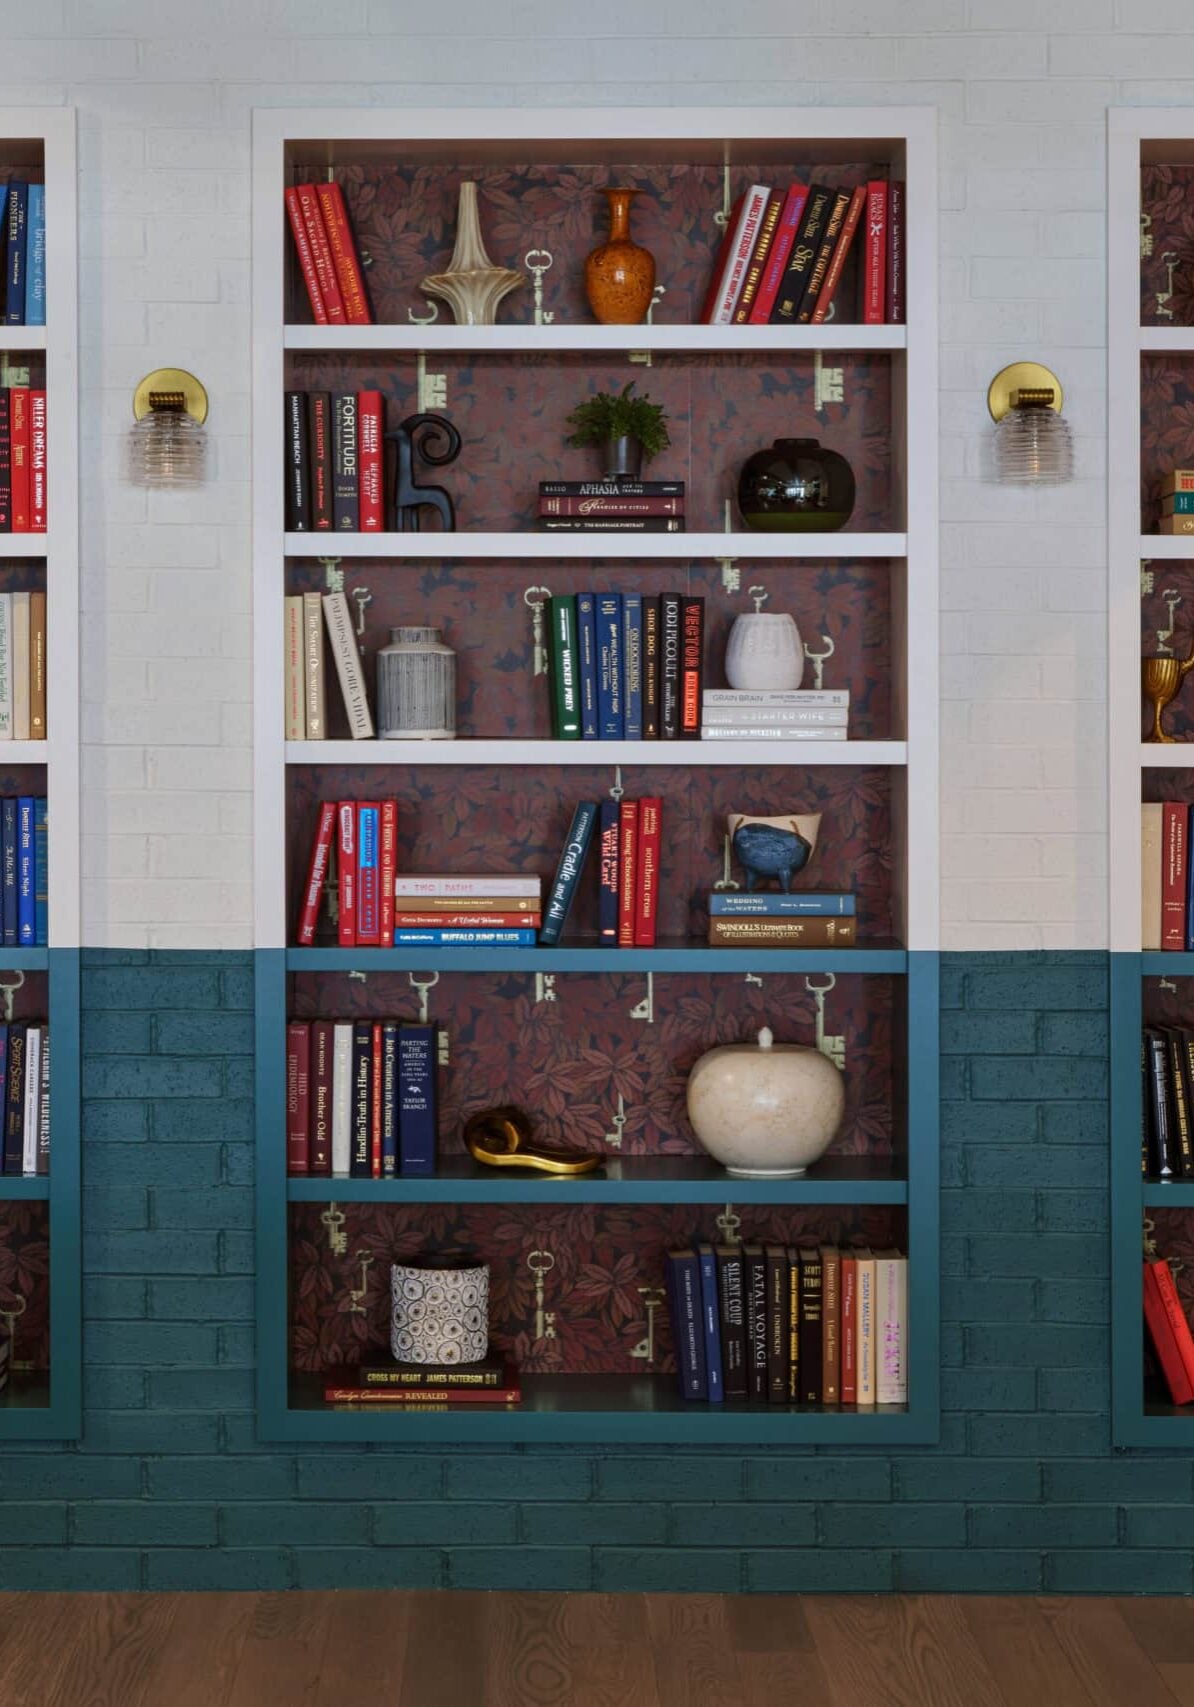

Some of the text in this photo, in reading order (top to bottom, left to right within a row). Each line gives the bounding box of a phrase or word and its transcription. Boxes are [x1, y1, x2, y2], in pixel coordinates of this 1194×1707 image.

[9, 192, 18, 240] PIONEERS
[737, 195, 764, 259] JAMES PATTERSON
[764, 200, 781, 232] THOMAS
[33, 228, 46, 263] bridge
[298, 233, 314, 277] AMERICAN
[301, 196, 330, 293] OUR SACRED HONOR
[755, 233, 771, 261] HARRIS
[790, 244, 815, 276] STAR
[31, 278, 44, 299] clay
[748, 267, 760, 284] CARI
[808, 257, 828, 296] COTTAGE
[33, 398, 45, 428] KILLER
[291, 396, 299, 438] MANHATTAN
[315, 400, 324, 460] THE CURIOSITY
[33, 432, 45, 469] DREAMS
[342, 397, 355, 476] FORTITUDE
[362, 415, 370, 454] CORNWELL
[370, 416, 378, 453] PATRICIA
[370, 463, 378, 504] DEPRAVED
[579, 484, 619, 495] APHASIA
[309, 615, 317, 629] THE
[647, 608, 655, 632] SHOE
[309, 631, 318, 657] SMART
[647, 636, 655, 656] DOG
[665, 601, 678, 680] JODI PICOULT
[330, 597, 368, 732] PALIMPSEST GORE VIDAL
[562, 649, 572, 685] WICKED
[631, 628, 639, 692] ON DOCTORING
[685, 605, 700, 722] VECTOR ROBIN COOK
[564, 687, 574, 712] PREY
[739, 694, 763, 702] BRAIN
[799, 712, 824, 721] WIFE
[313, 869, 322, 879] for
[314, 843, 327, 869] Intended
[549, 811, 589, 920] PATTERSON Cradle and All
[602, 830, 610, 885] Wild Card
[623, 829, 633, 911] Among Schoolchildren
[643, 848, 654, 890] southern
[442, 933, 475, 941] BUFFALO
[477, 933, 495, 941] JUMP
[497, 933, 519, 941] BLUES
[386, 1039, 395, 1053] Job
[289, 1055, 297, 1113] EPIDEMIOLOGY
[299, 1073, 307, 1095] FIELD
[356, 1055, 370, 1098] in History
[385, 1054, 395, 1089] Creation
[40, 1094, 50, 1146] WILDERNESS
[318, 1086, 327, 1119] Brother
[385, 1100, 395, 1137] America
[317, 1122, 327, 1141] Odd
[728, 1263, 742, 1325] SILENT COUP
[862, 1273, 870, 1338] SUSAN MALLERY
[755, 1265, 766, 1368] FATAL VOYAGE
[368, 1374, 483, 1383] CROSS MY HEART JAMES PATTERSON
[405, 1392, 448, 1400] REVEALED
